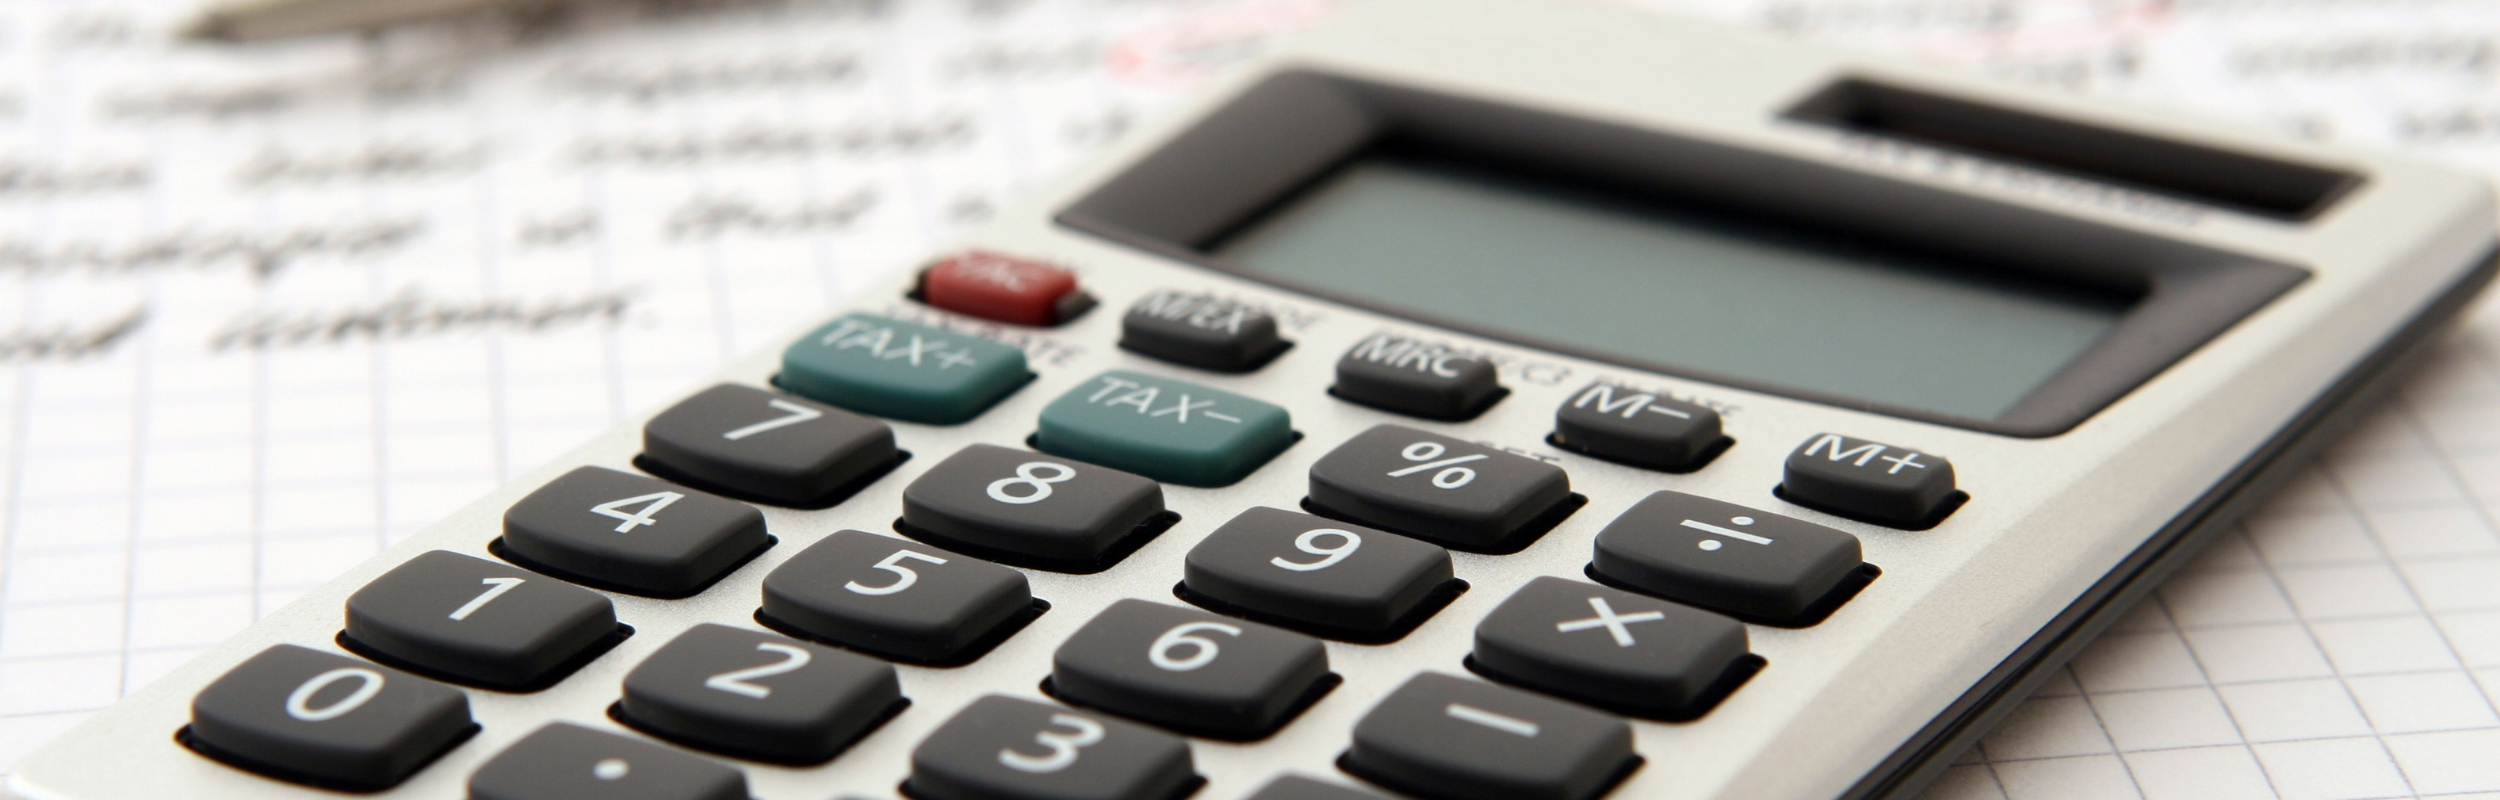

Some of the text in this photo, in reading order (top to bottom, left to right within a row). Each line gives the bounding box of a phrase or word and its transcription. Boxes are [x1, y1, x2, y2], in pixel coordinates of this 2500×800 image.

[818, 317, 978, 367] TAX+
[1352, 332, 1460, 378] MRC
[723, 400, 822, 440] 7
[1387, 442, 1489, 489] %
[1804, 434, 1926, 475] M+
[986, 461, 1077, 504] 8
[590, 491, 686, 534] 4
[843, 550, 949, 596] 5
[1270, 528, 1362, 572] 9
[448, 577, 526, 621] 1
[1147, 621, 1242, 671] 6
[705, 643, 811, 698] 2
[286, 669, 385, 721] 0
[999, 713, 1105, 772] 3
